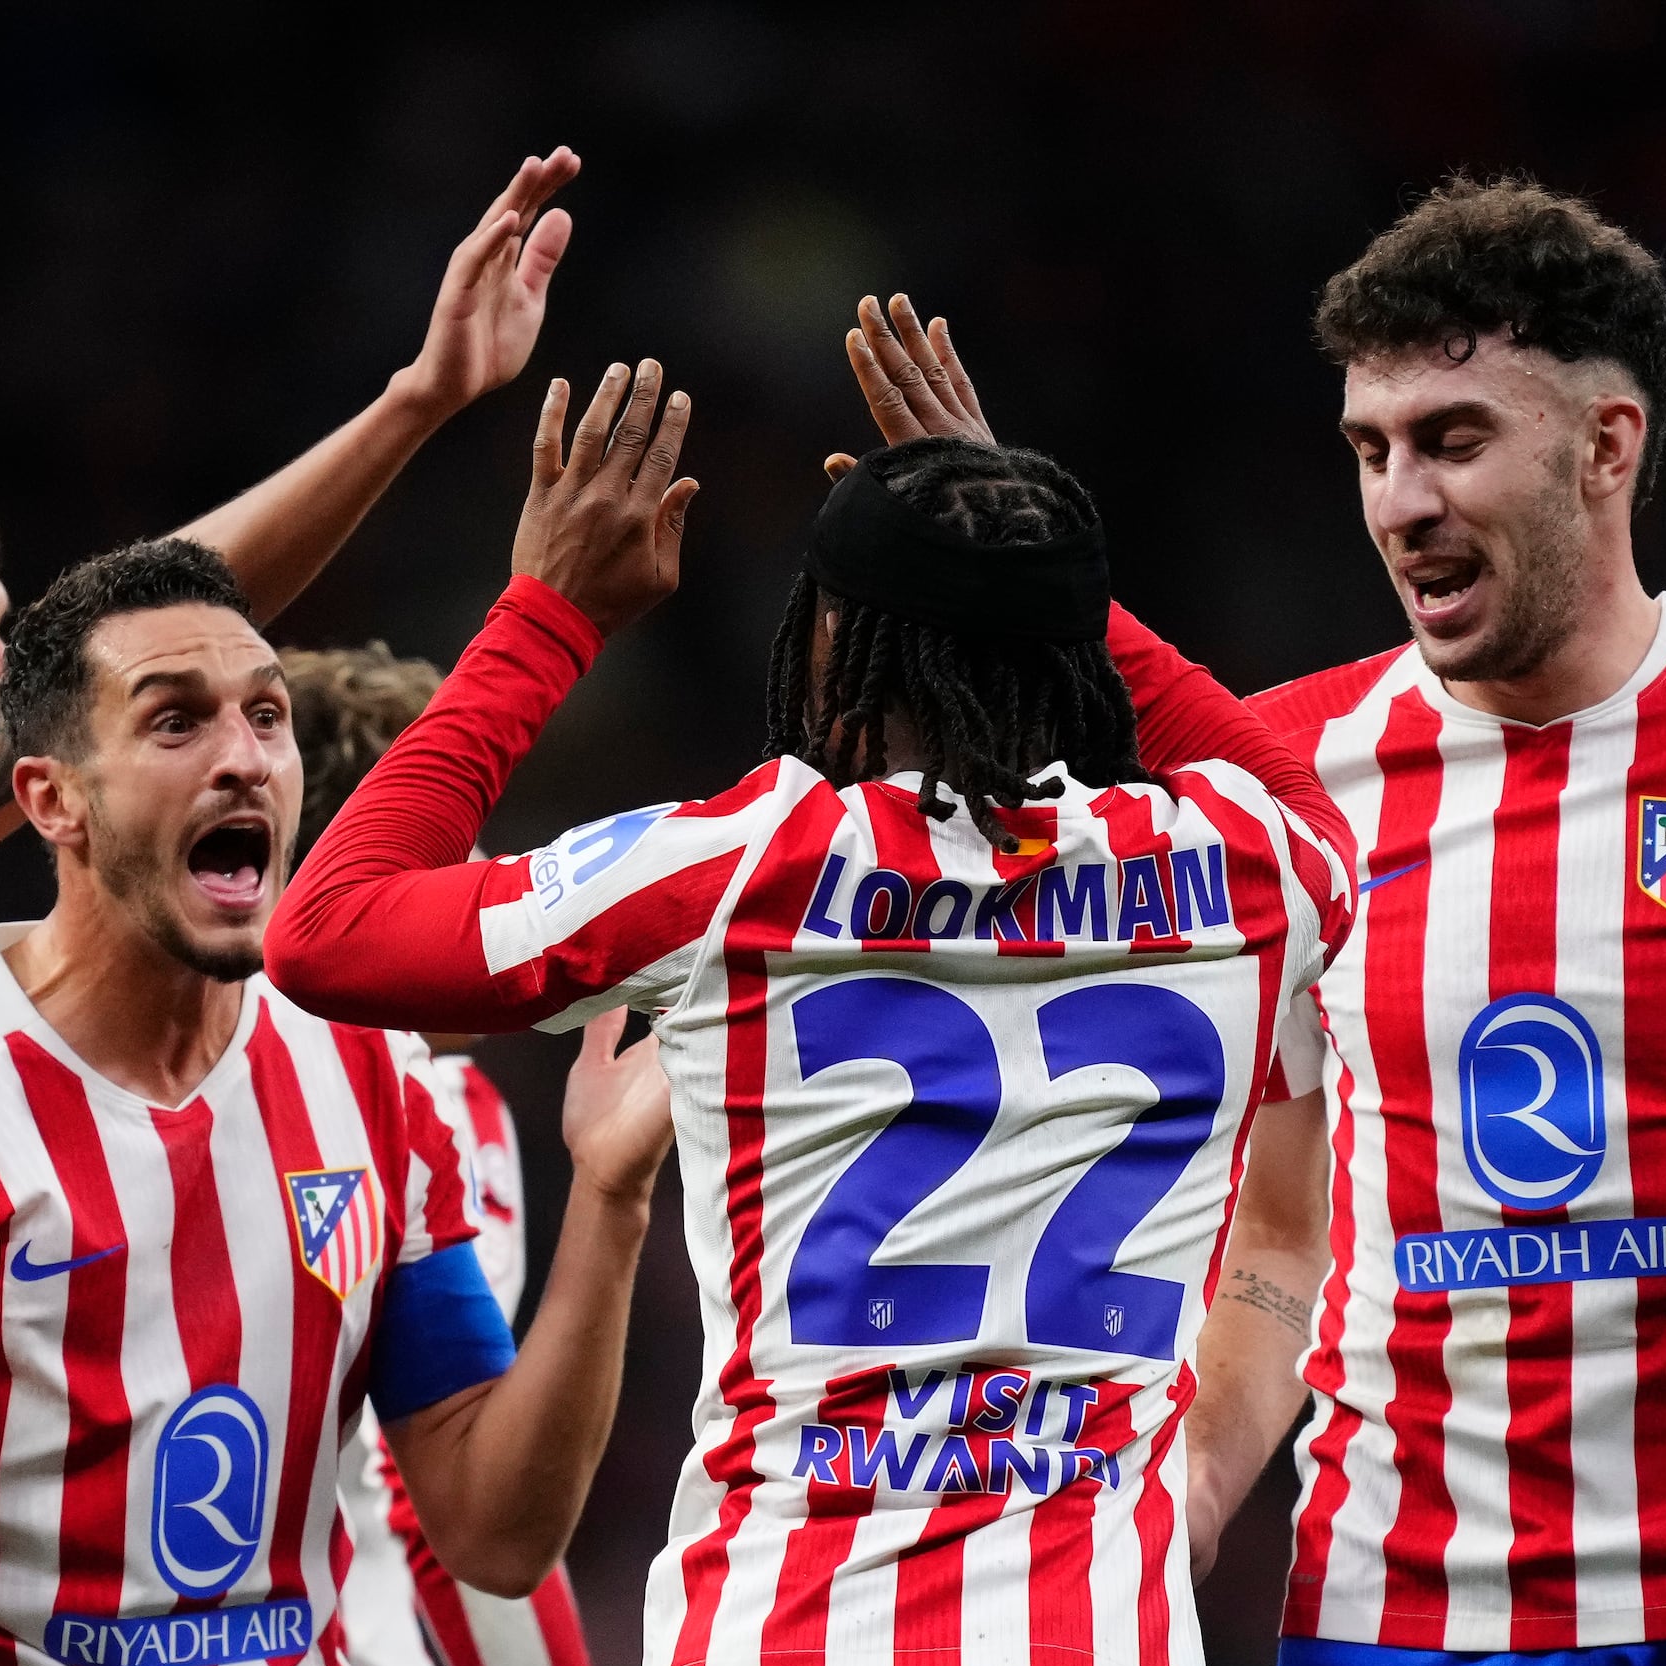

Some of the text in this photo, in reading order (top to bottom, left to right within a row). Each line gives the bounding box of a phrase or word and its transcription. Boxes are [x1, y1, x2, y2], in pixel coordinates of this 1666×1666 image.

[801, 843, 1230, 941] LOOKMAN
[786, 976, 1226, 1361] 22
[1405, 1231, 1594, 1286] RIYADH
[888, 1368, 1098, 1444] VISIT
[60, 1603, 306, 1666] RIYADH AIR
